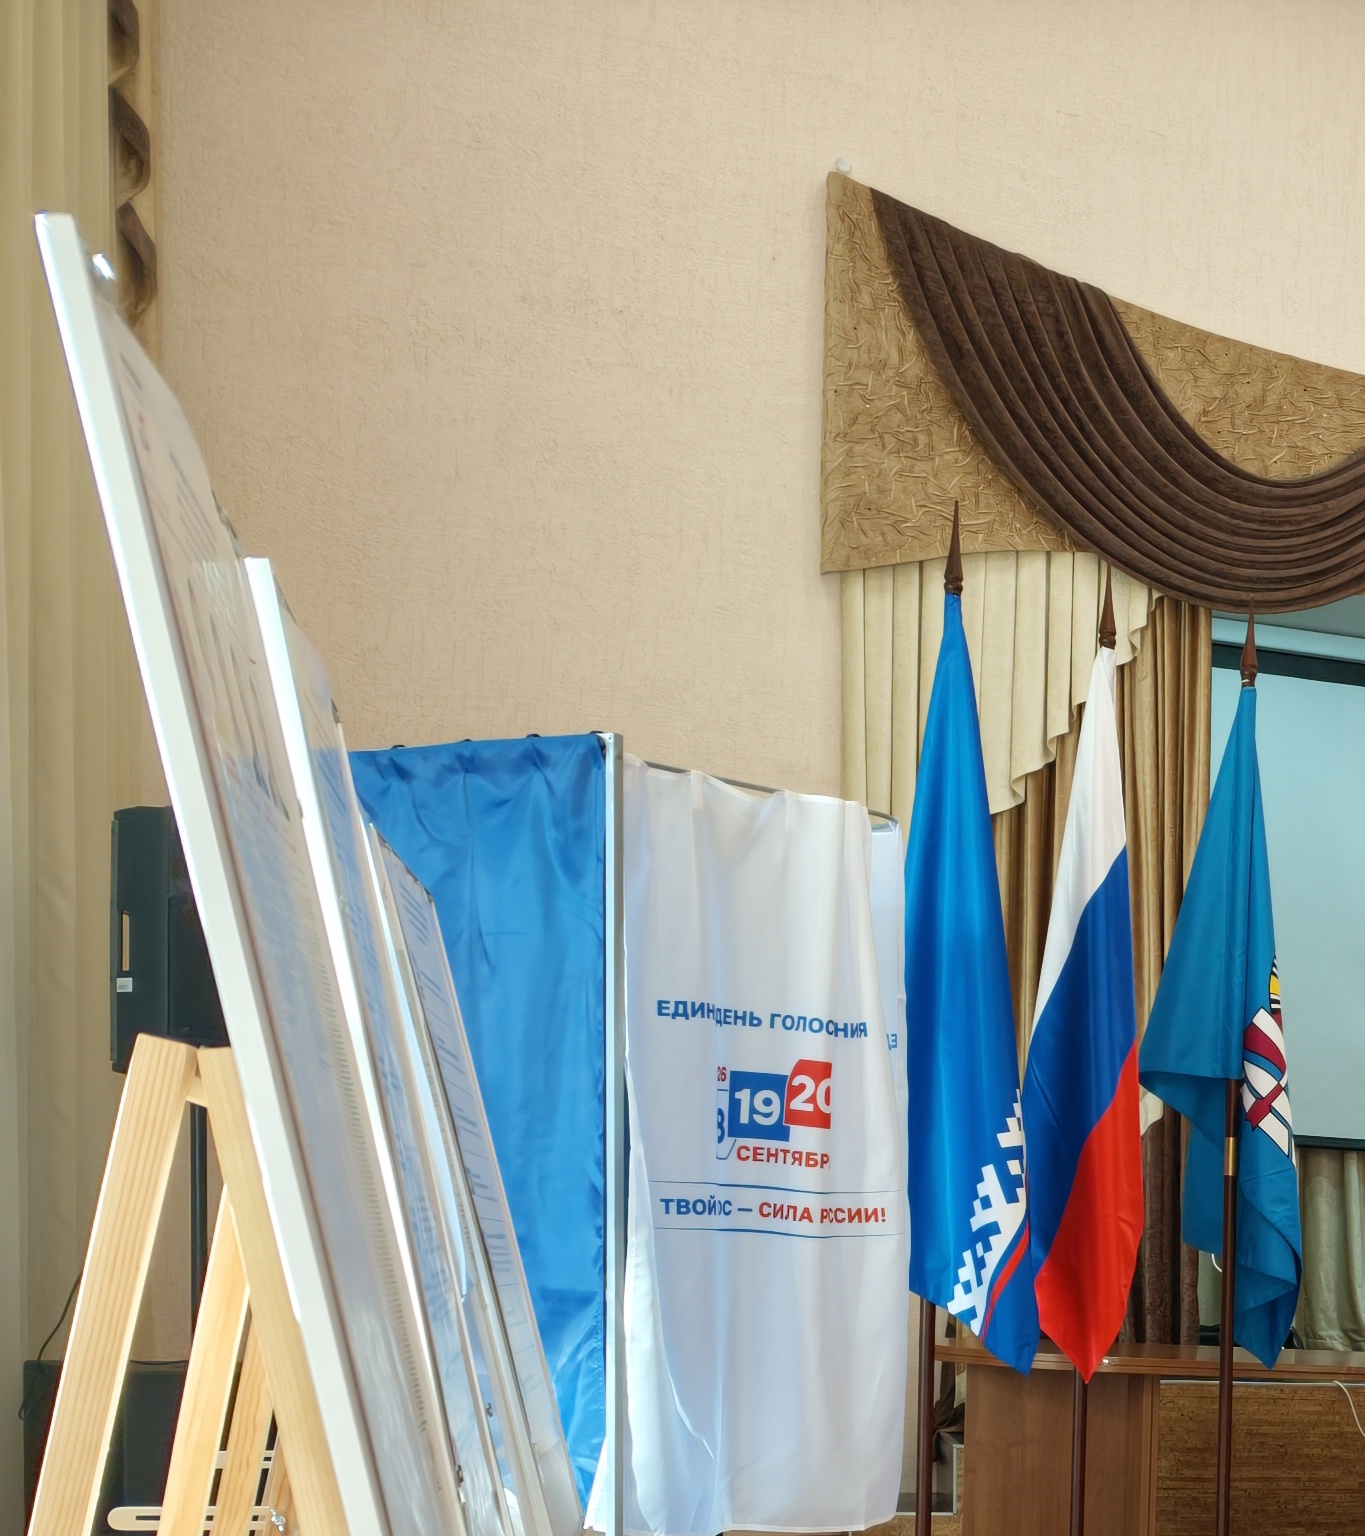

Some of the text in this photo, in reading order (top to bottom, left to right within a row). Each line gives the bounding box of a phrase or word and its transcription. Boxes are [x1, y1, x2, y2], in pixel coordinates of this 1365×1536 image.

[734, 1088, 781, 1126] 19
[736, 1145, 831, 1170] СЕНТЯБР
[659, 1194, 717, 1216] ТВОЙ
[758, 1201, 814, 1223] СИЛА
